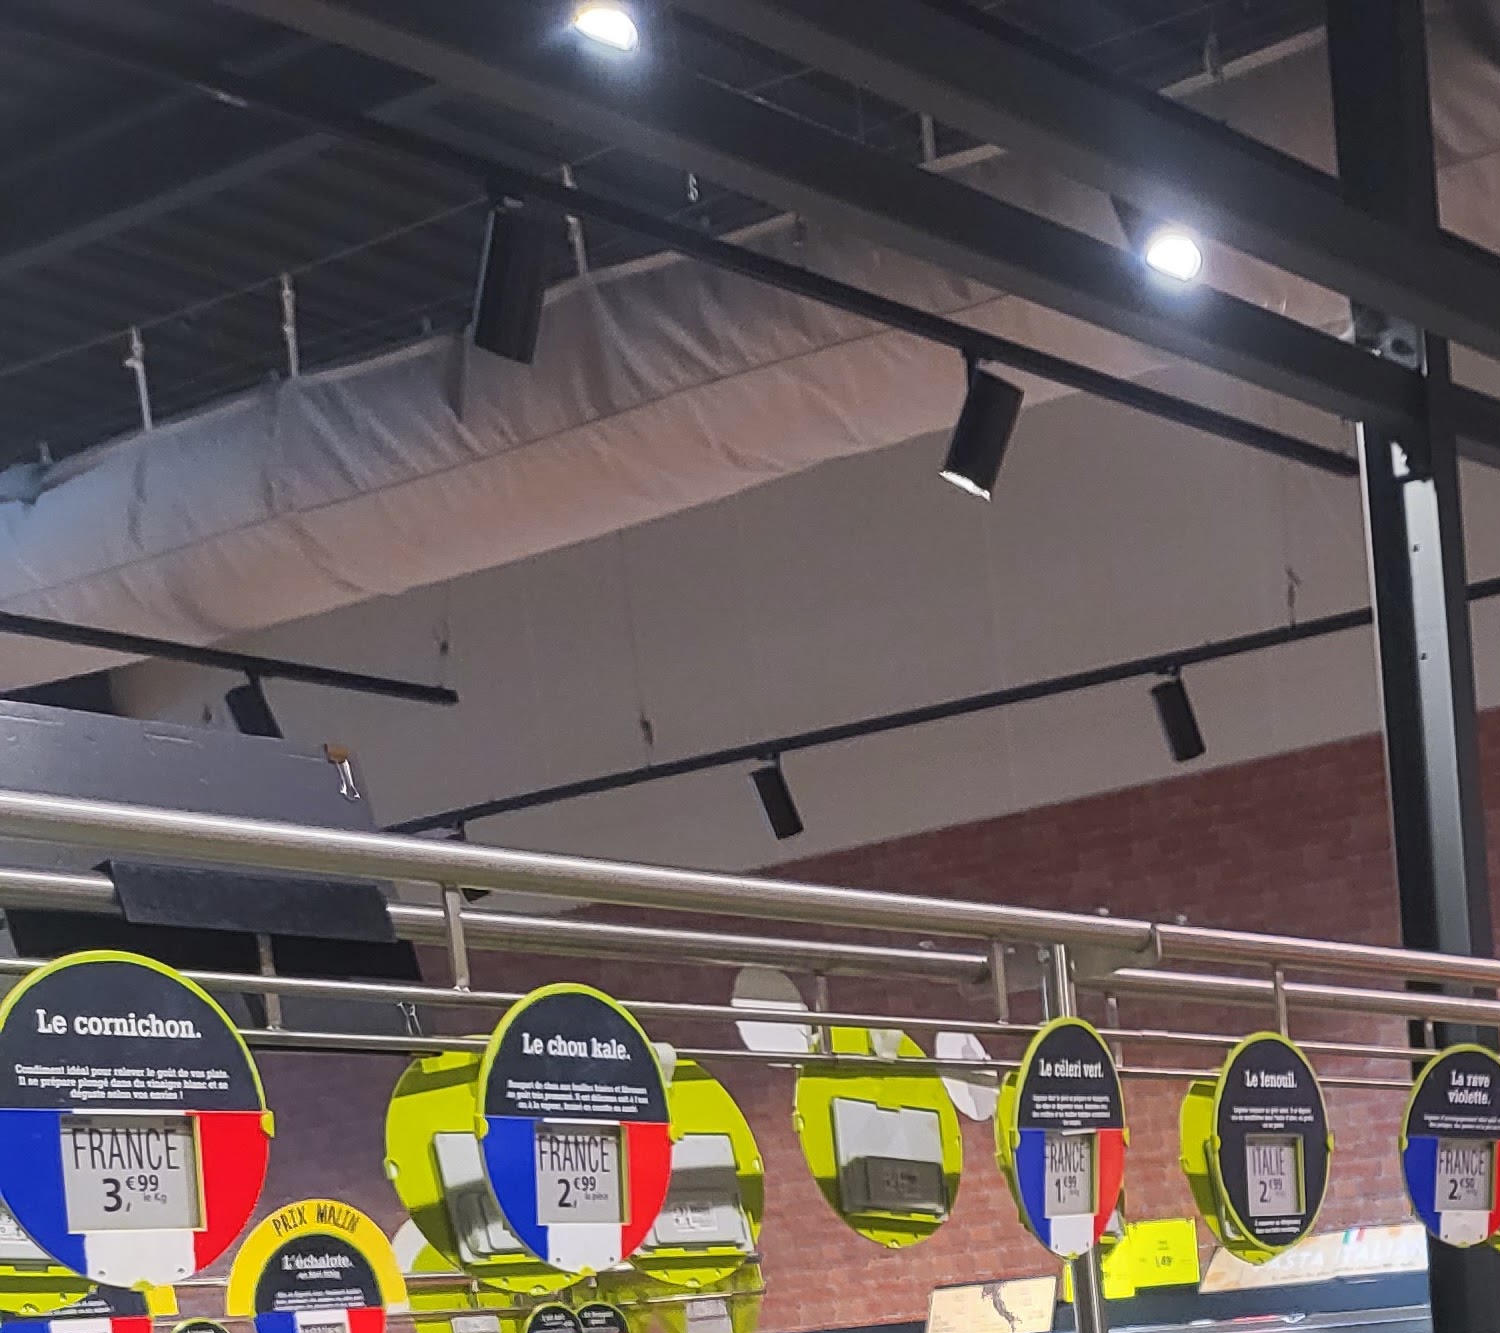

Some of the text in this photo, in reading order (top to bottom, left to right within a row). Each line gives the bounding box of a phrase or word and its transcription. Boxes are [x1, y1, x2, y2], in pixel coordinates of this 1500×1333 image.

[36, 1009, 201, 1038] Le cornichon.
[522, 1032, 632, 1061] Le chou kale.
[1039, 1059, 1104, 1078] Le céleri vert.
[1244, 1070, 1297, 1089] Le fenouil.
[1451, 1069, 1490, 1088] La rave
[1448, 1088, 1491, 1105] violette.
[72, 1128, 180, 1170] FRANCE
[538, 1135, 610, 1173] FRANCE
[1252, 1147, 1285, 1176] ITALIE
[1439, 1150, 1485, 1176] FRANCE
[272, 1203, 361, 1237] PRIX MALIN
